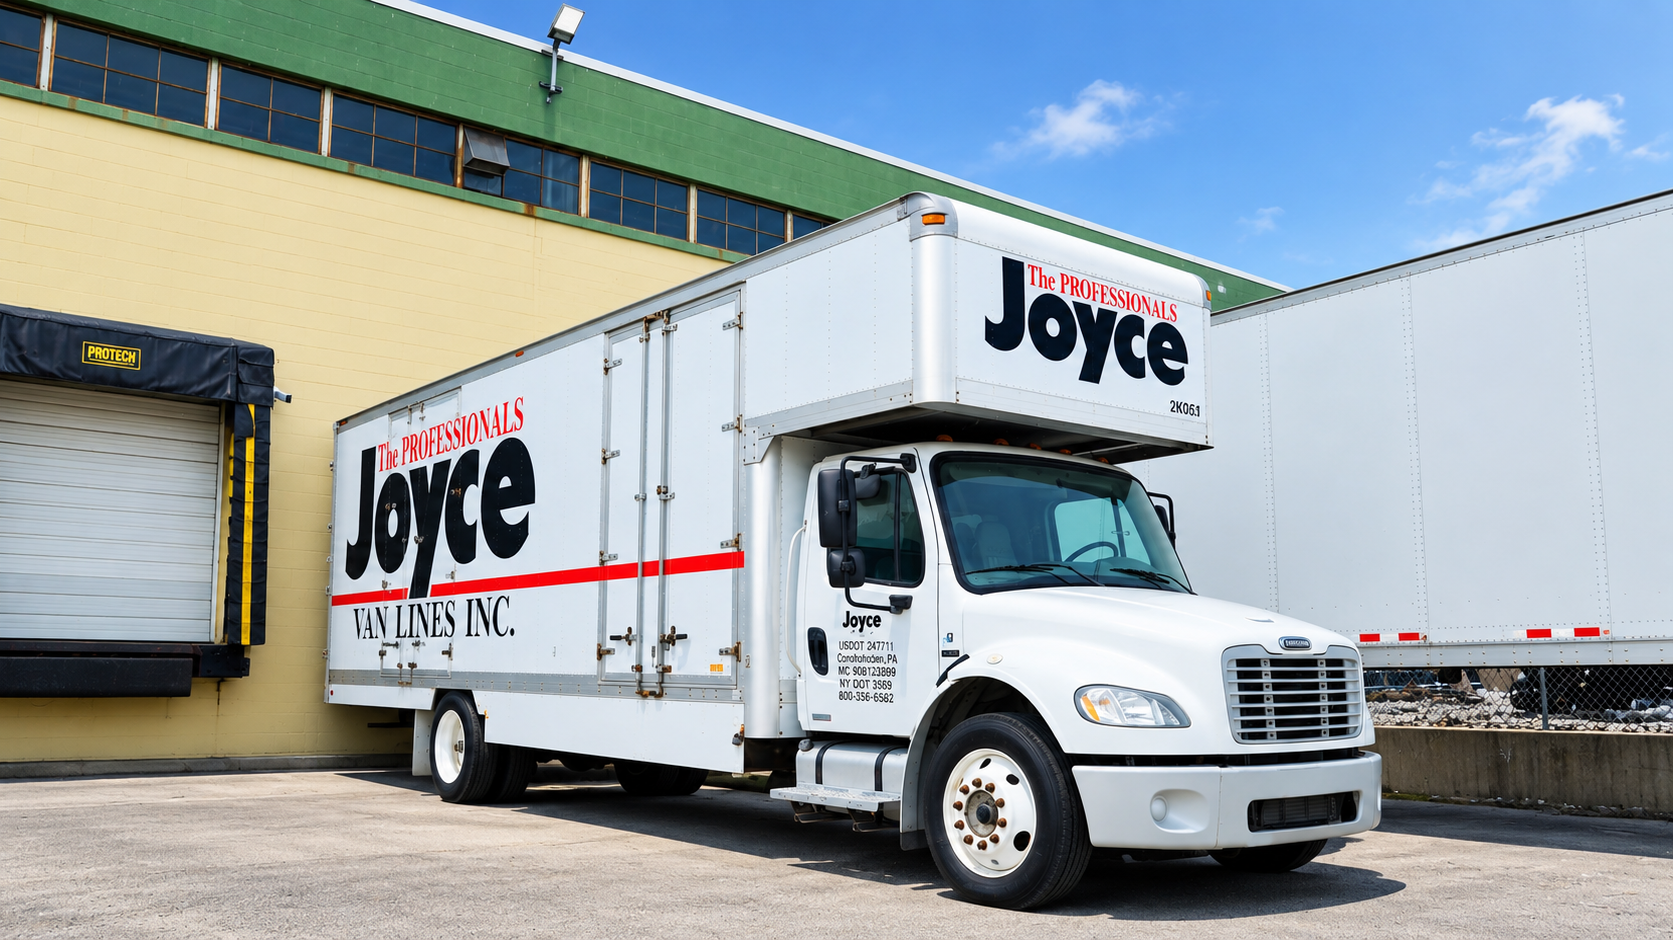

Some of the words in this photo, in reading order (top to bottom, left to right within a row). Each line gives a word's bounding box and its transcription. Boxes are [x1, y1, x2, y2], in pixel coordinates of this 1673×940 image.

[1028, 264, 1055, 291] The
[1060, 272, 1178, 323] PROFESSIONALS
[985, 256, 1188, 386] Joyce
[88, 345, 136, 363] PROTECH
[378, 441, 398, 472] The
[401, 396, 524, 466] PROFESSIONALS
[345, 437, 536, 599] Joyce
[353, 606, 389, 640] VAN
[395, 600, 456, 639] LINES
[465, 595, 515, 637] INC.
[842, 611, 882, 633] Joyce
[838, 641, 864, 651] USDOT
[867, 641, 894, 651] 247711
[838, 666, 851, 676] MC
[839, 679, 851, 688] NY
[853, 679, 870, 689] DOT
